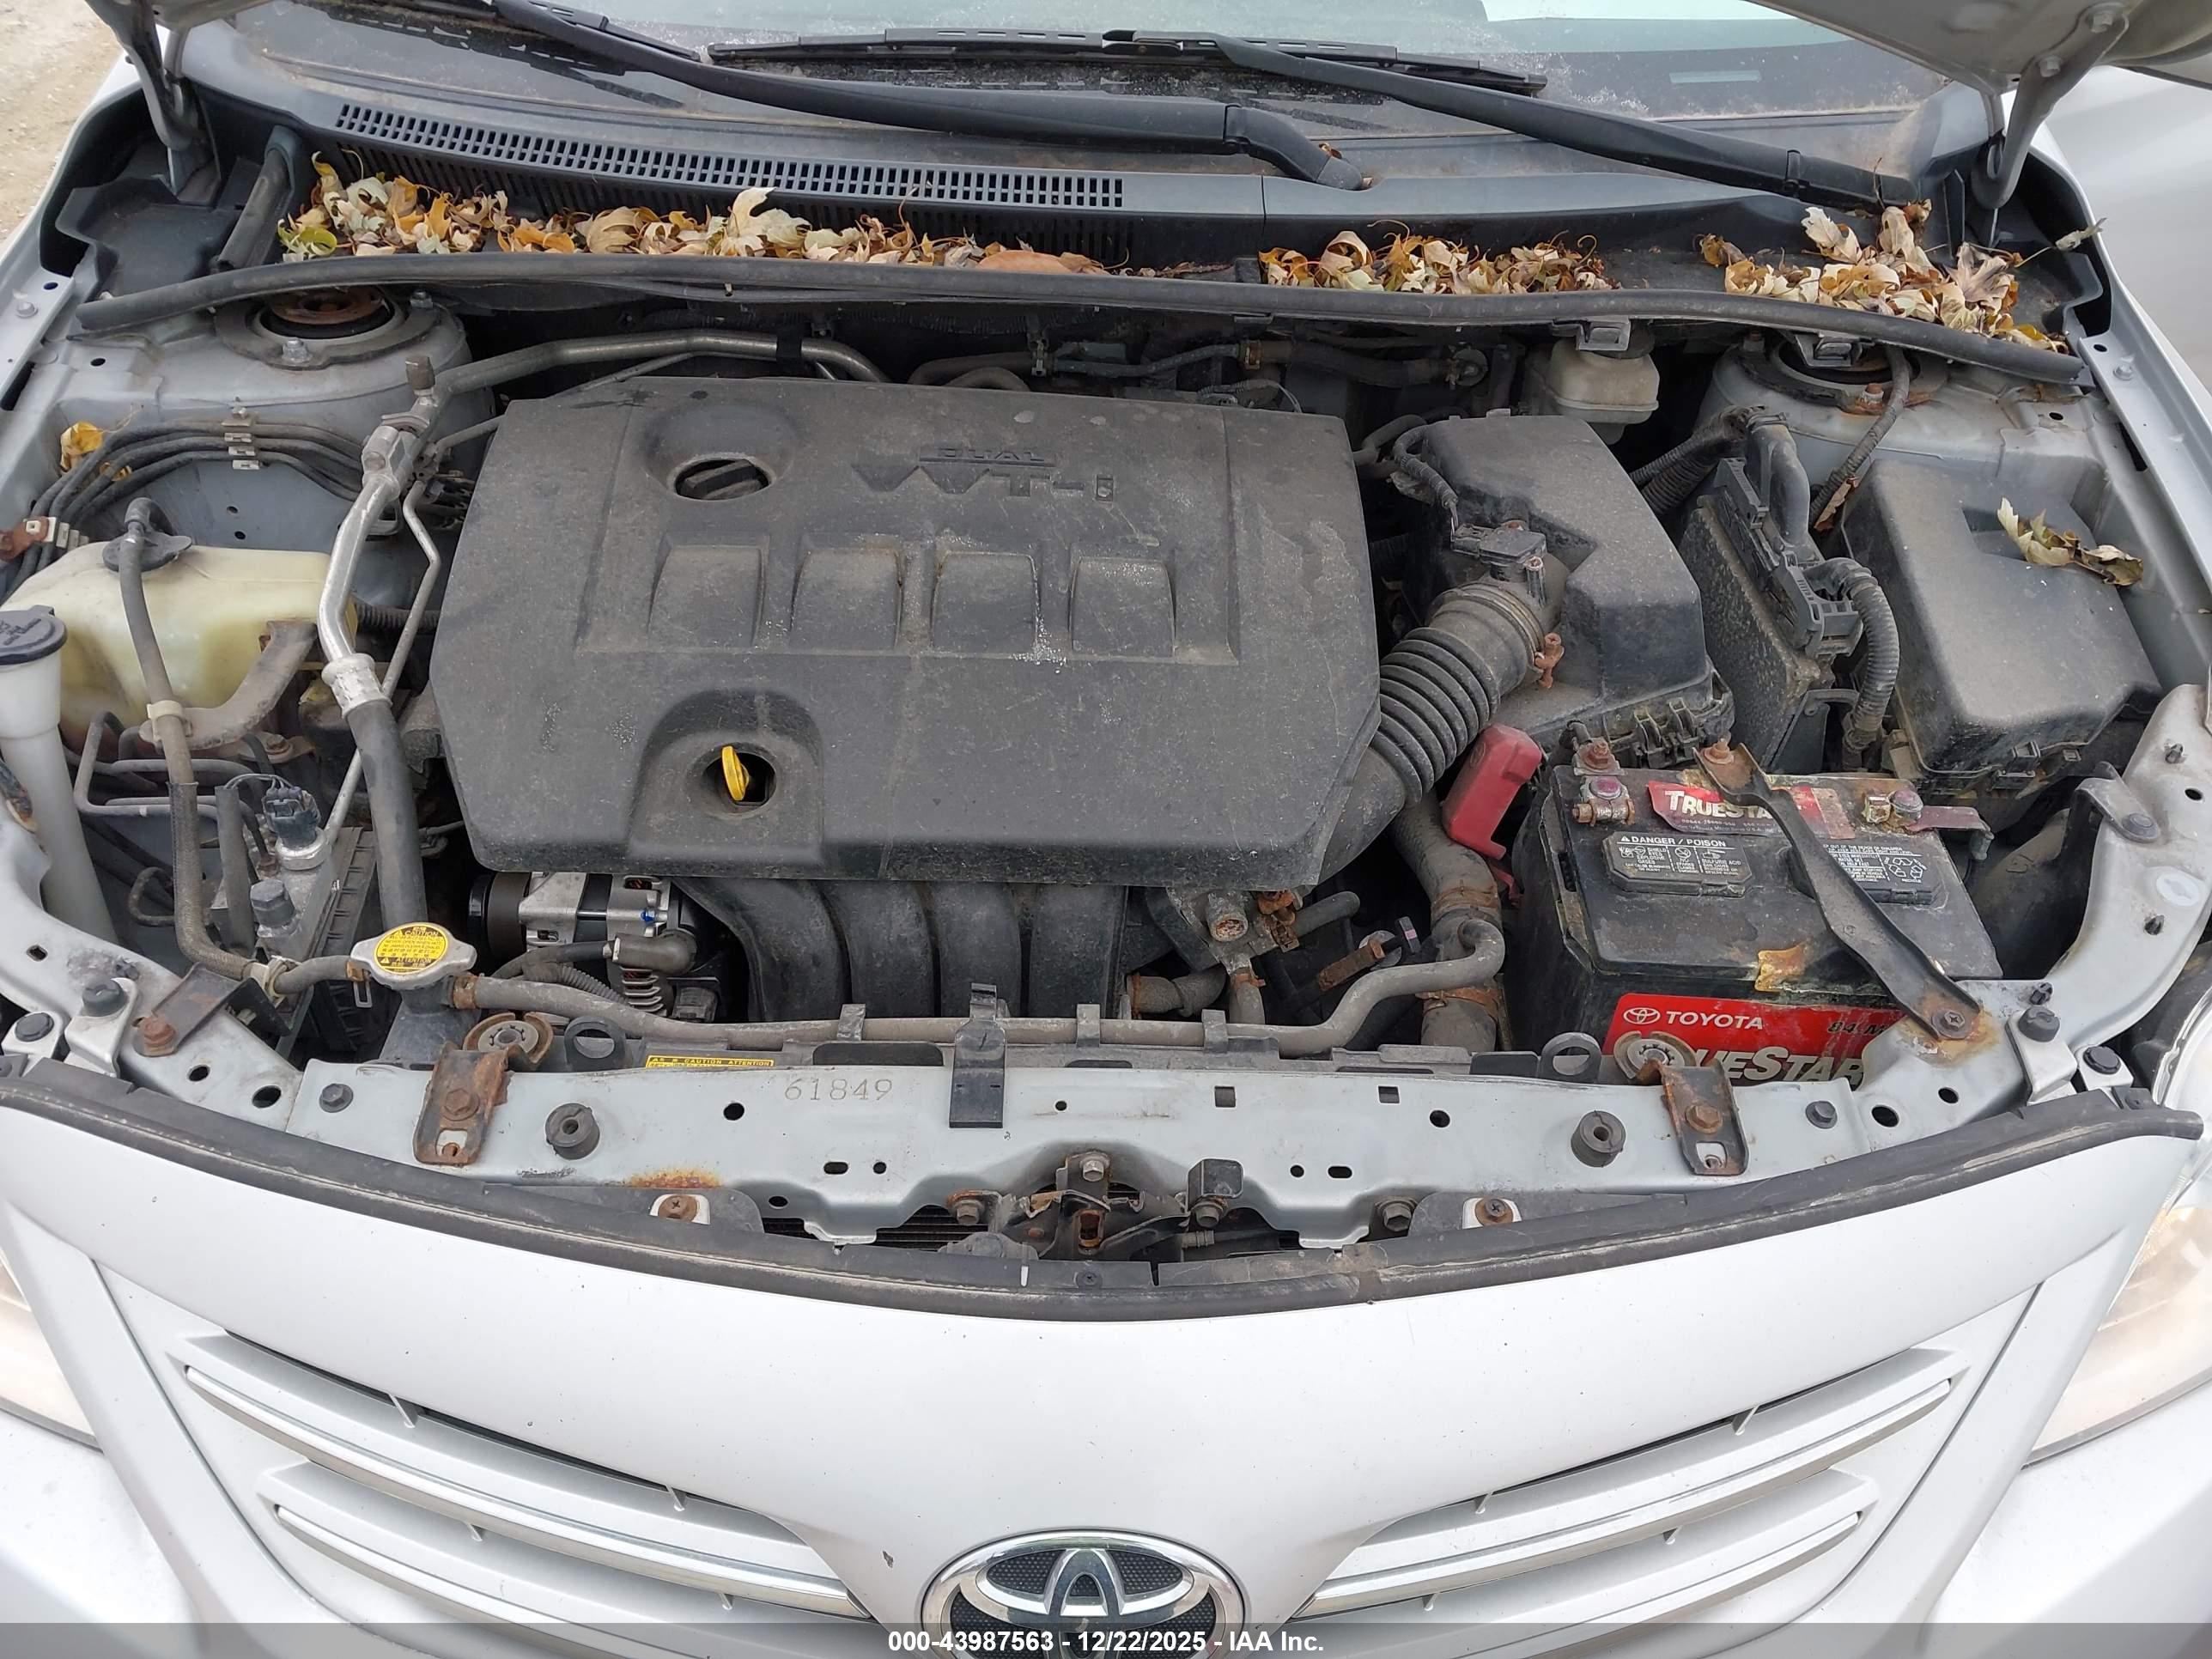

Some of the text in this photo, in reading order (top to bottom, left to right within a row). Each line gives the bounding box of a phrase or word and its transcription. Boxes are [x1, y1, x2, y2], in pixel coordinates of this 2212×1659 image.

[1664, 790, 1773, 819] TRUESTA
[1632, 836, 1675, 845] DANGER
[1686, 838, 1726, 847] POISON
[1665, 1011, 1763, 1030] TOYOTA
[784, 1078, 893, 1101] 61849
